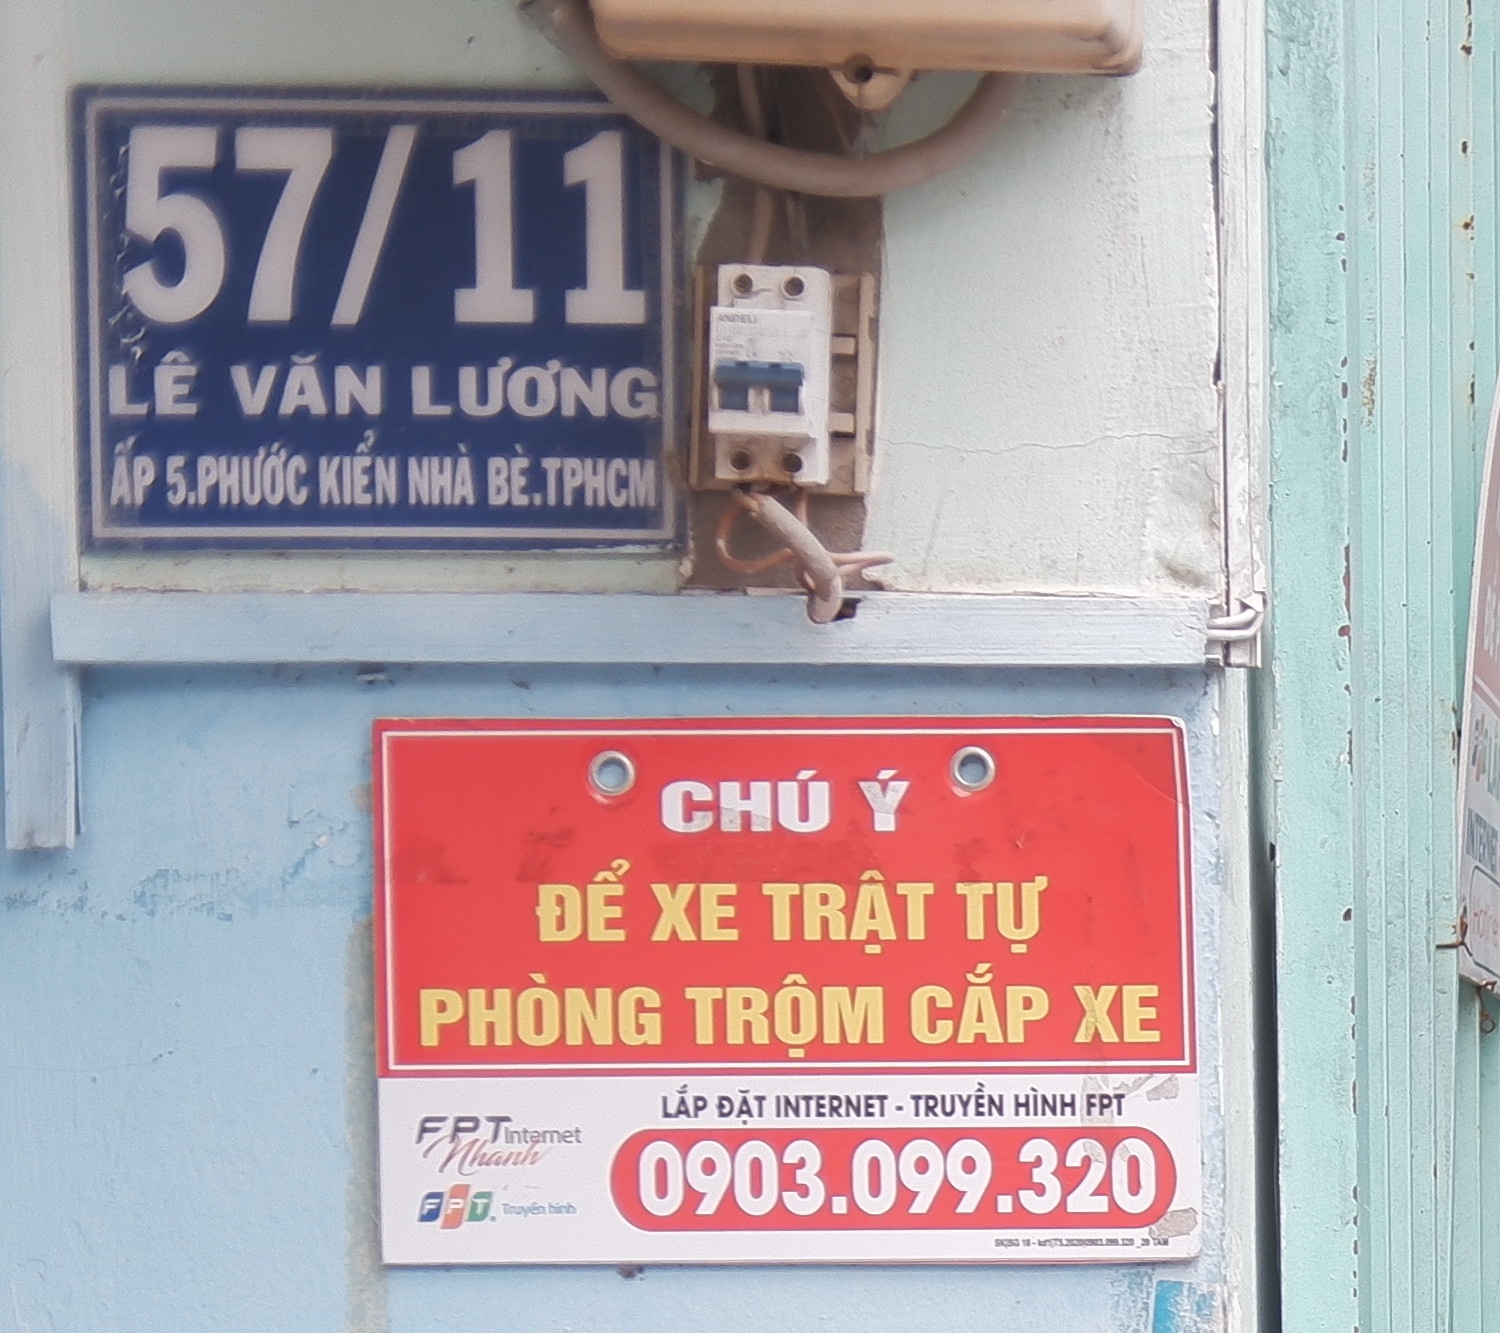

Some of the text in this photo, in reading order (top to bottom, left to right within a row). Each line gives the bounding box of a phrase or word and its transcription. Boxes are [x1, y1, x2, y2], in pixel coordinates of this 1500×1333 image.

[120, 126, 647, 326] 57/11
[108, 350, 660, 420] LÊ VĂN LƯƠNG
[109, 438, 160, 507] ẤP
[317, 430, 398, 507] KIỂN
[405, 446, 476, 508] NHÀ
[659, 769, 910, 834] CHÚ Ý
[536, 858, 1048, 955] ĐỂ XE TRẬT TỰ
[418, 962, 1161, 1058] PHÒNG TRỘM CẮP XE
[415, 1116, 583, 1145] FPT Internet
[661, 1084, 708, 1119] LẮP
[715, 1089, 766, 1126] ĐẶT
[774, 1095, 888, 1119] INTERNET
[911, 1084, 1010, 1119] TRUYỀN
[1015, 1086, 1080, 1118] HÌNH
[1085, 1093, 1126, 1117] FPT
[422, 1134, 545, 1176] Nhanh
[638, 1137, 1157, 1217] 0903.099.320
[417, 1184, 495, 1229] FPT
